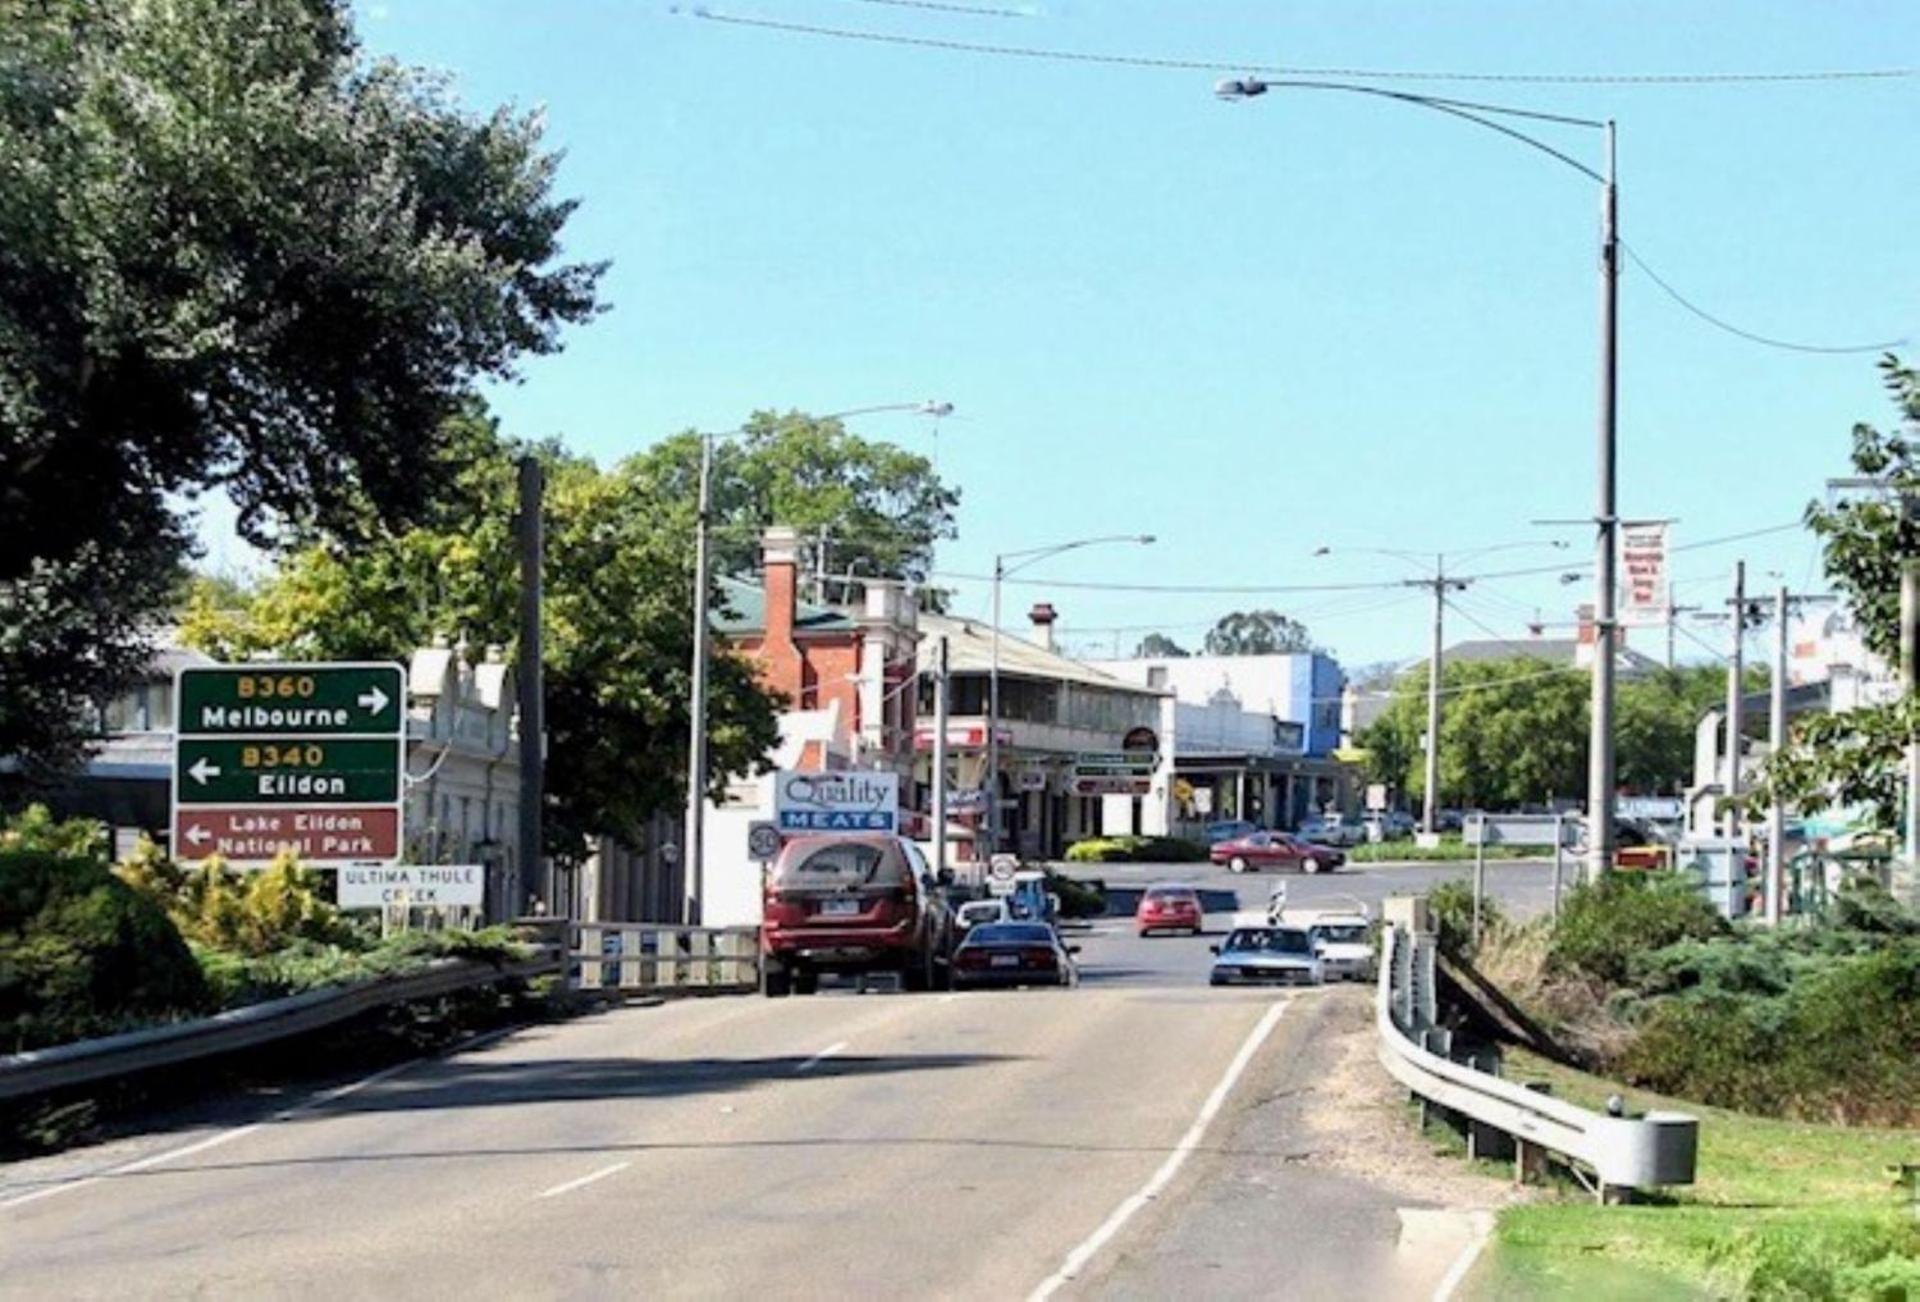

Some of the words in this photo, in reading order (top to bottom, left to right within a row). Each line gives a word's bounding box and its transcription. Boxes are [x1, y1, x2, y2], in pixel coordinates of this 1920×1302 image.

[237, 676, 315, 698] B360
[202, 706, 348, 727] Melbourne
[242, 745, 323, 767] B340
[258, 775, 345, 794] Eildon
[786, 776, 889, 812] Quality
[229, 815, 281, 831] Lake
[294, 814, 363, 831] Eildon
[787, 813, 886, 827] MEATS
[322, 836, 374, 853] Park
[345, 870, 411, 884] ULTIMA
[419, 869, 475, 884] THULE
